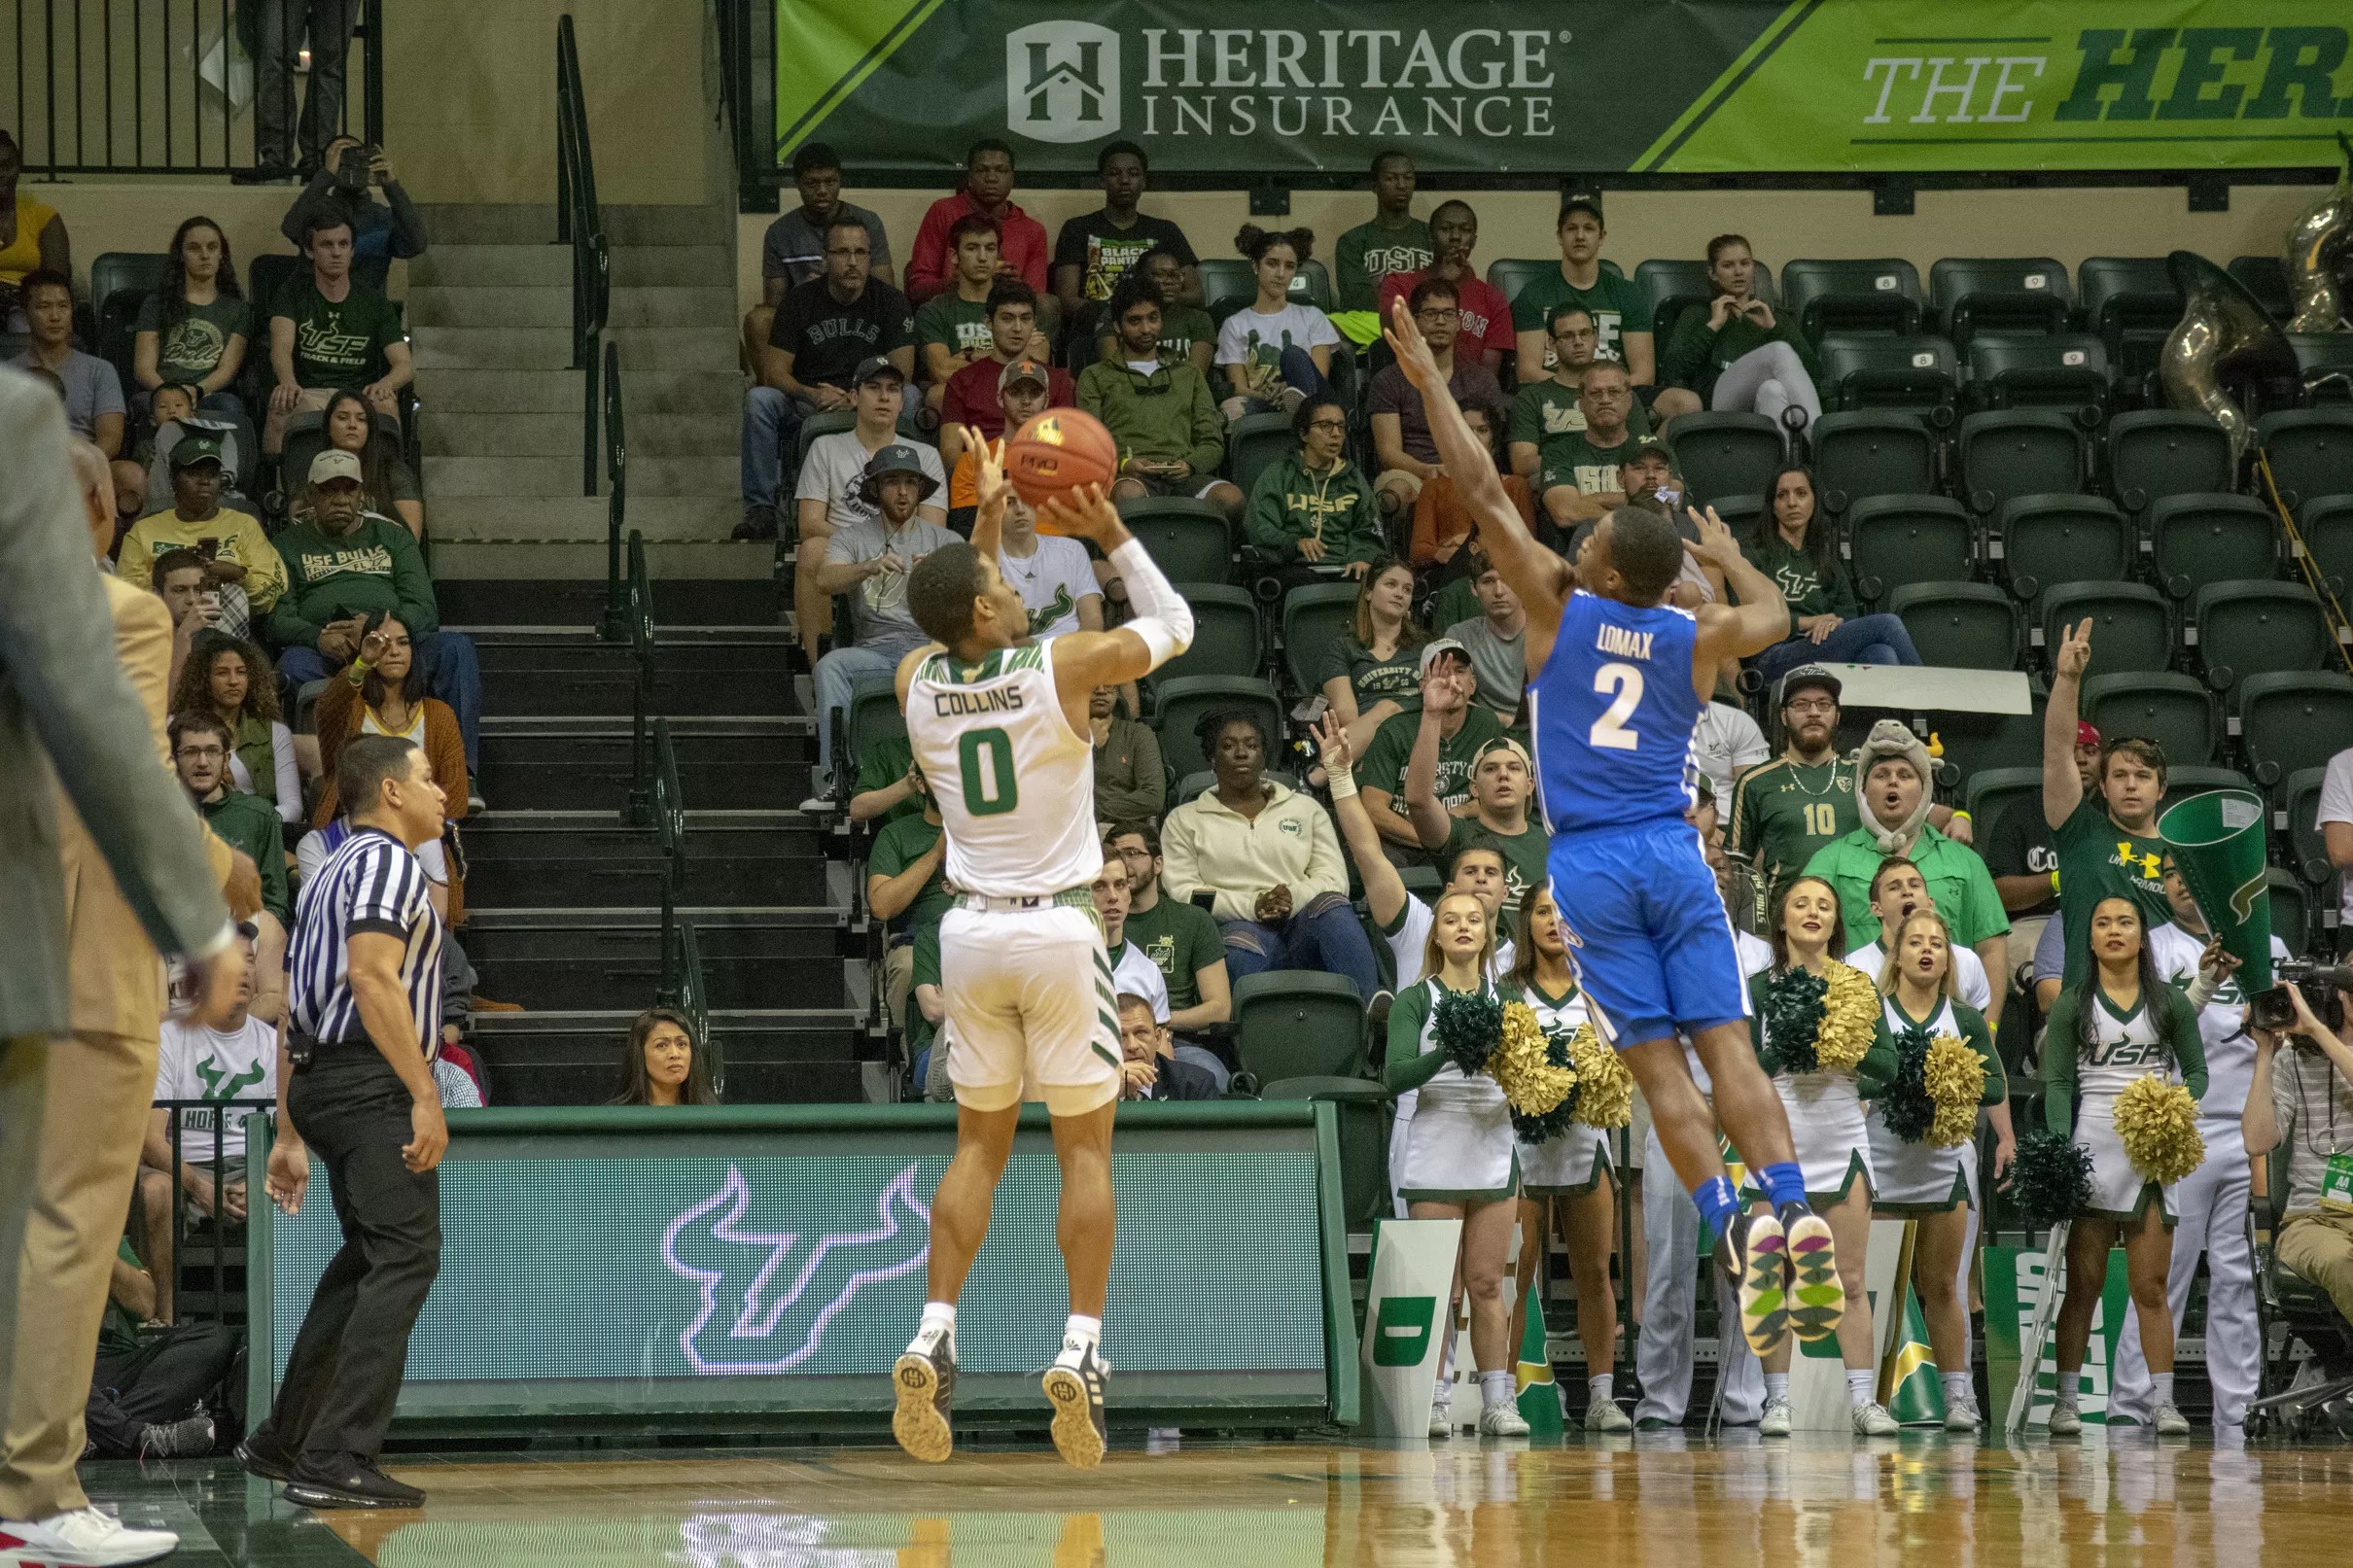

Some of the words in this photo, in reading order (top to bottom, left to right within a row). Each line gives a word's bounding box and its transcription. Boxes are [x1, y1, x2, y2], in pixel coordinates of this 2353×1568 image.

[1141, 28, 1555, 89] HERITAGE
[1863, 56, 2047, 124] THE
[2053, 26, 2353, 122] HER
[1141, 95, 1556, 137] INSURANCE
[806, 318, 881, 345] BULLS
[955, 323, 993, 339] US
[339, 355, 366, 366] FIELD
[1286, 494, 1358, 512] USF
[301, 553, 333, 567] USF
[335, 543, 388, 565] BULLS
[1597, 623, 1655, 661] LOMAX
[1357, 667, 1413, 688] UNIVERSITY
[934, 685, 1023, 717] COLLINS
[1590, 663, 1645, 751] 2
[1804, 803, 1836, 836] 10
[2129, 875, 2167, 895] ARMOU
